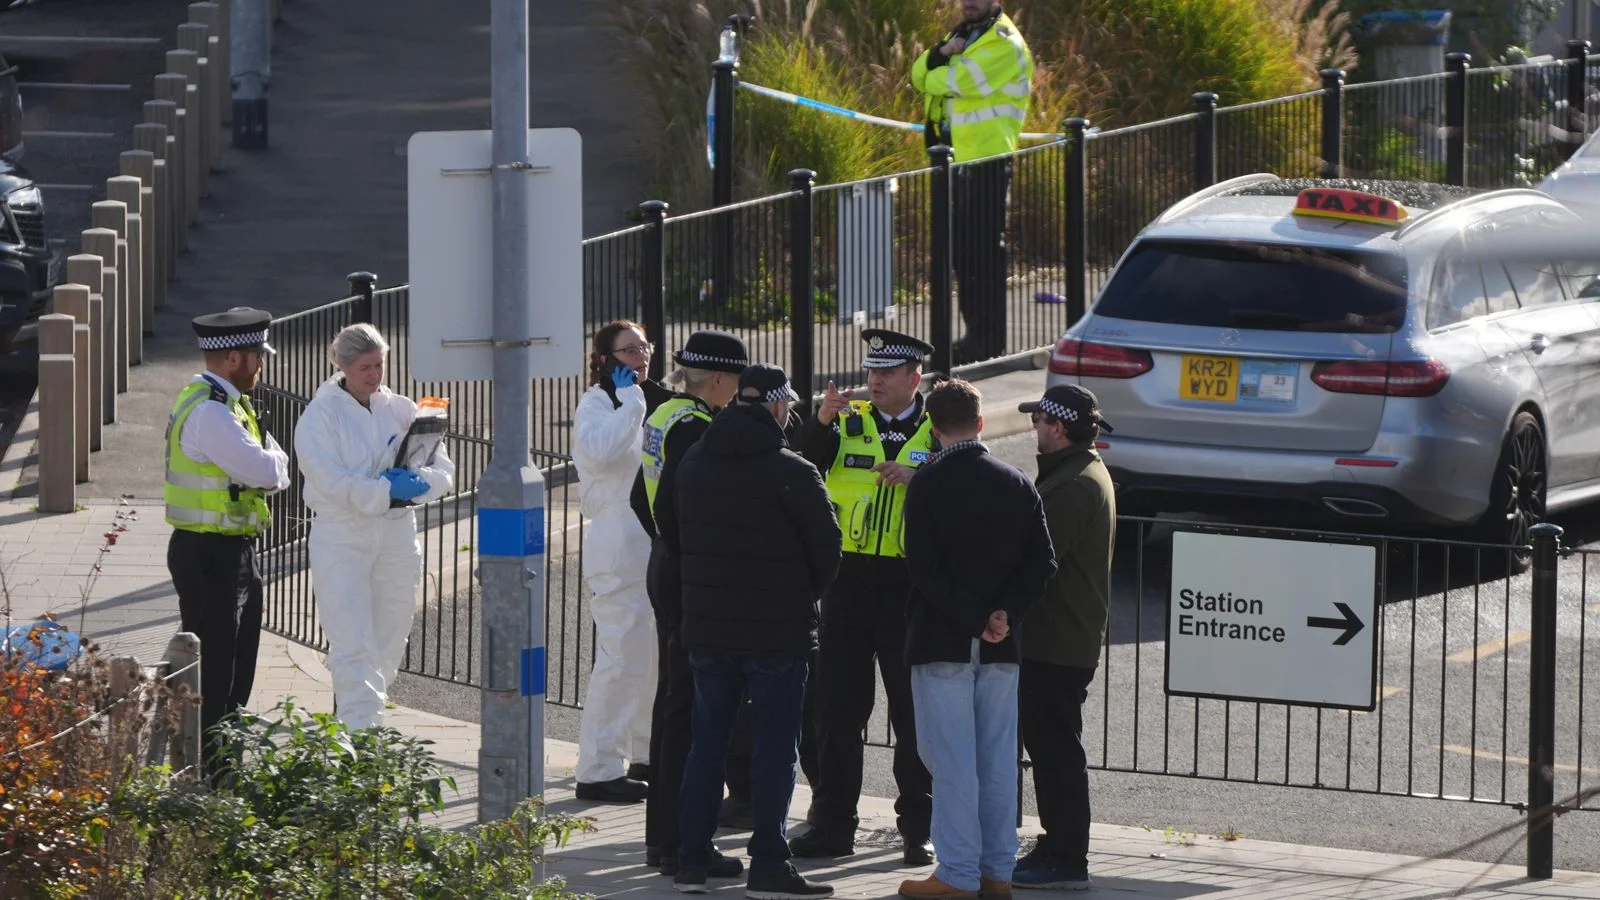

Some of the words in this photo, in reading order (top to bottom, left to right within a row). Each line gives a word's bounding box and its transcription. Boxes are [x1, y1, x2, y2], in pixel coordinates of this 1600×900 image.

[1306, 192, 1388, 216] TAXI
[1188, 359, 1232, 377] KR21
[1190, 378, 1228, 396] WYD
[1179, 589, 1263, 615] Station
[1179, 614, 1286, 643] Entrance
